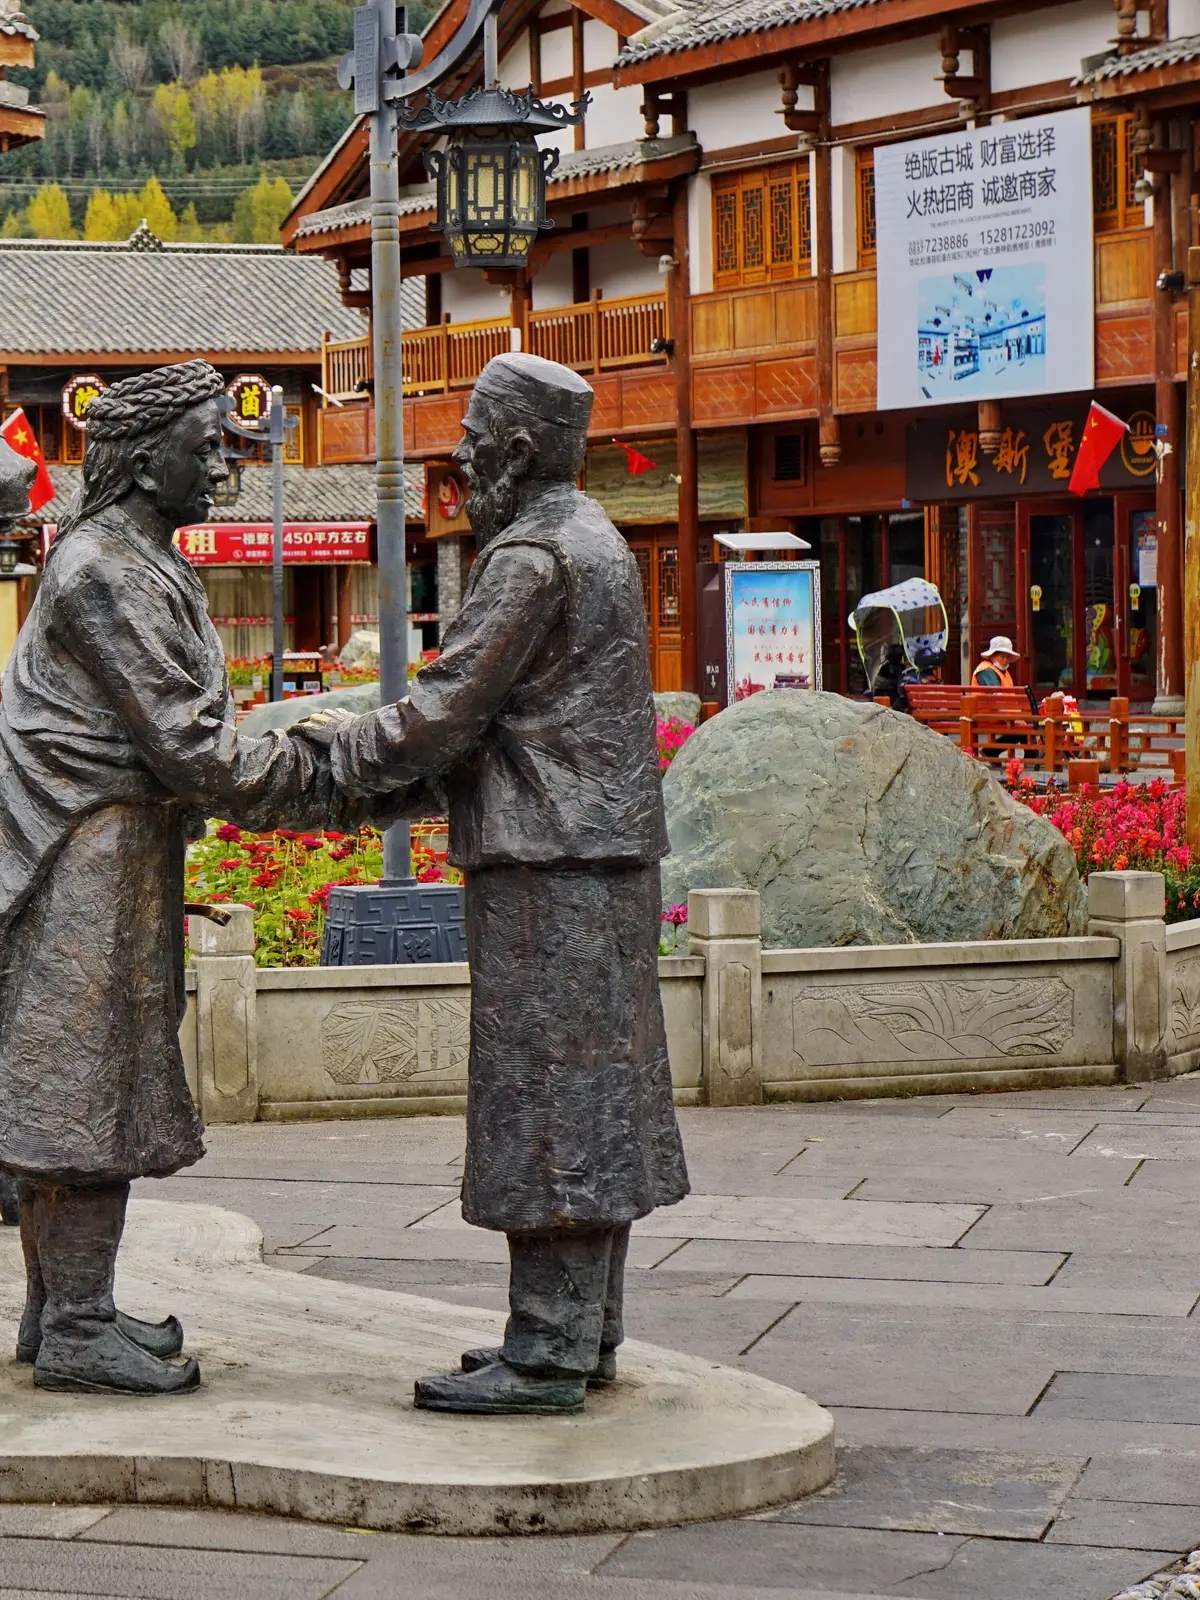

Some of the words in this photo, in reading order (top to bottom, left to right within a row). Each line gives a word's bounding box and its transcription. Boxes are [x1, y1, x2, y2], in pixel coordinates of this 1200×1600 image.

[905, 142, 974, 180] 绝版古城
[980, 127, 1056, 168] 财富选择
[906, 181, 974, 219] 火热招商
[981, 166, 1057, 206] 诚邀商家
[925, 233, 969, 253] 7238886
[980, 220, 1055, 245] 15281723092
[229, 531, 366, 545] 一楼整450平方左右
[741, 597, 792, 608] 人民有信仰
[747, 624, 799, 636] 国家有力量
